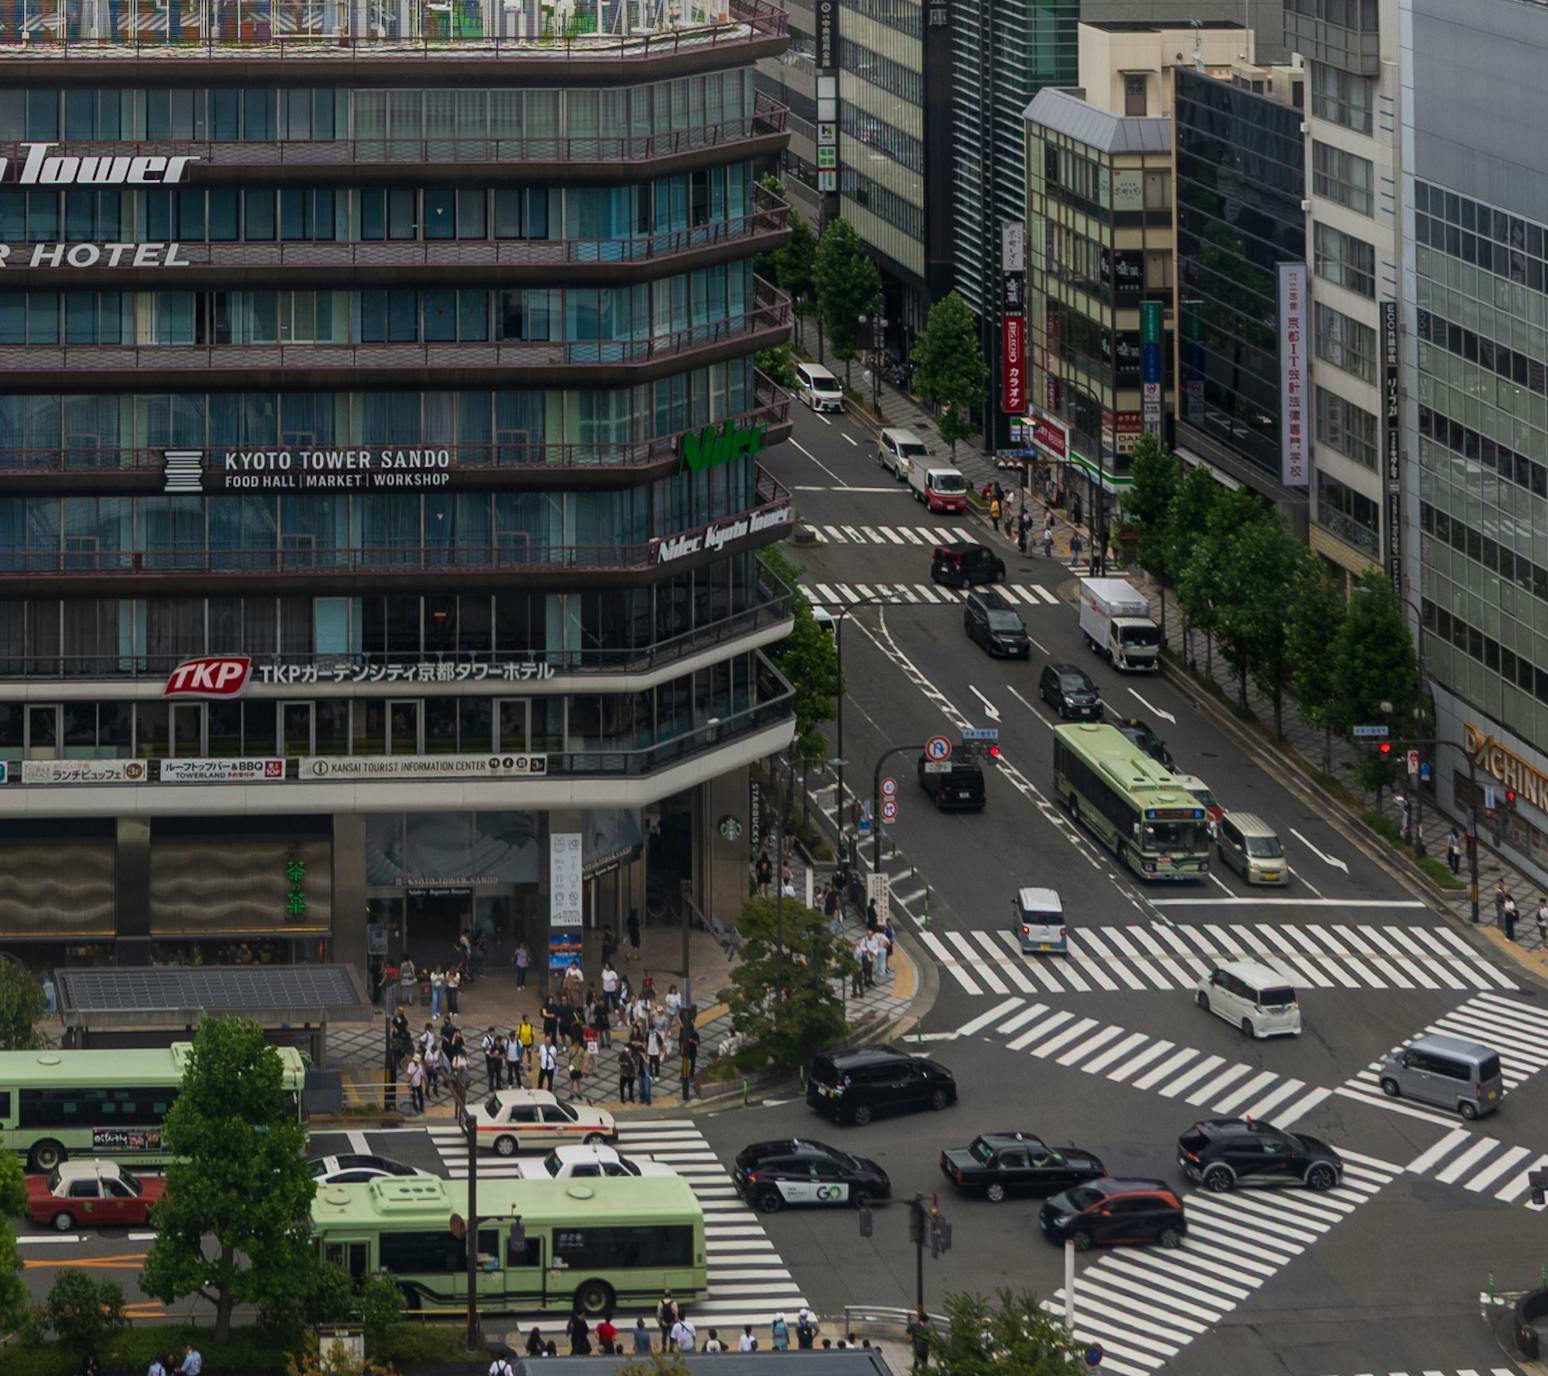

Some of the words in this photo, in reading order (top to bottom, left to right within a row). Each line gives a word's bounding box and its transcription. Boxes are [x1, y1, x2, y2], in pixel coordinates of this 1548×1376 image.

[20, 143, 201, 185] Tower
[29, 243, 191, 269] HOTEL
[1009, 367, 1019, 408] カラオケ
[225, 451, 292, 470] KYOTO
[300, 451, 371, 469] TOWER
[380, 450, 449, 469] SANDO
[225, 476, 261, 488] FOOD
[263, 475, 296, 488] HALL
[306, 474, 362, 488] MARKET
[373, 473, 450, 487] WORKSHOP
[174, 662, 243, 689] TKP
[259, 662, 555, 685] TKPガーデンシティ京都タワーホテル
[53, 770, 121, 781] ランチビュッフェ
[331, 762, 361, 773] KANSAI
[364, 762, 398, 772] TOURIST
[401, 761, 454, 772] INFORMATION
[455, 760, 487, 771] CENTER
[752, 783, 760, 844] STARBUCKS
